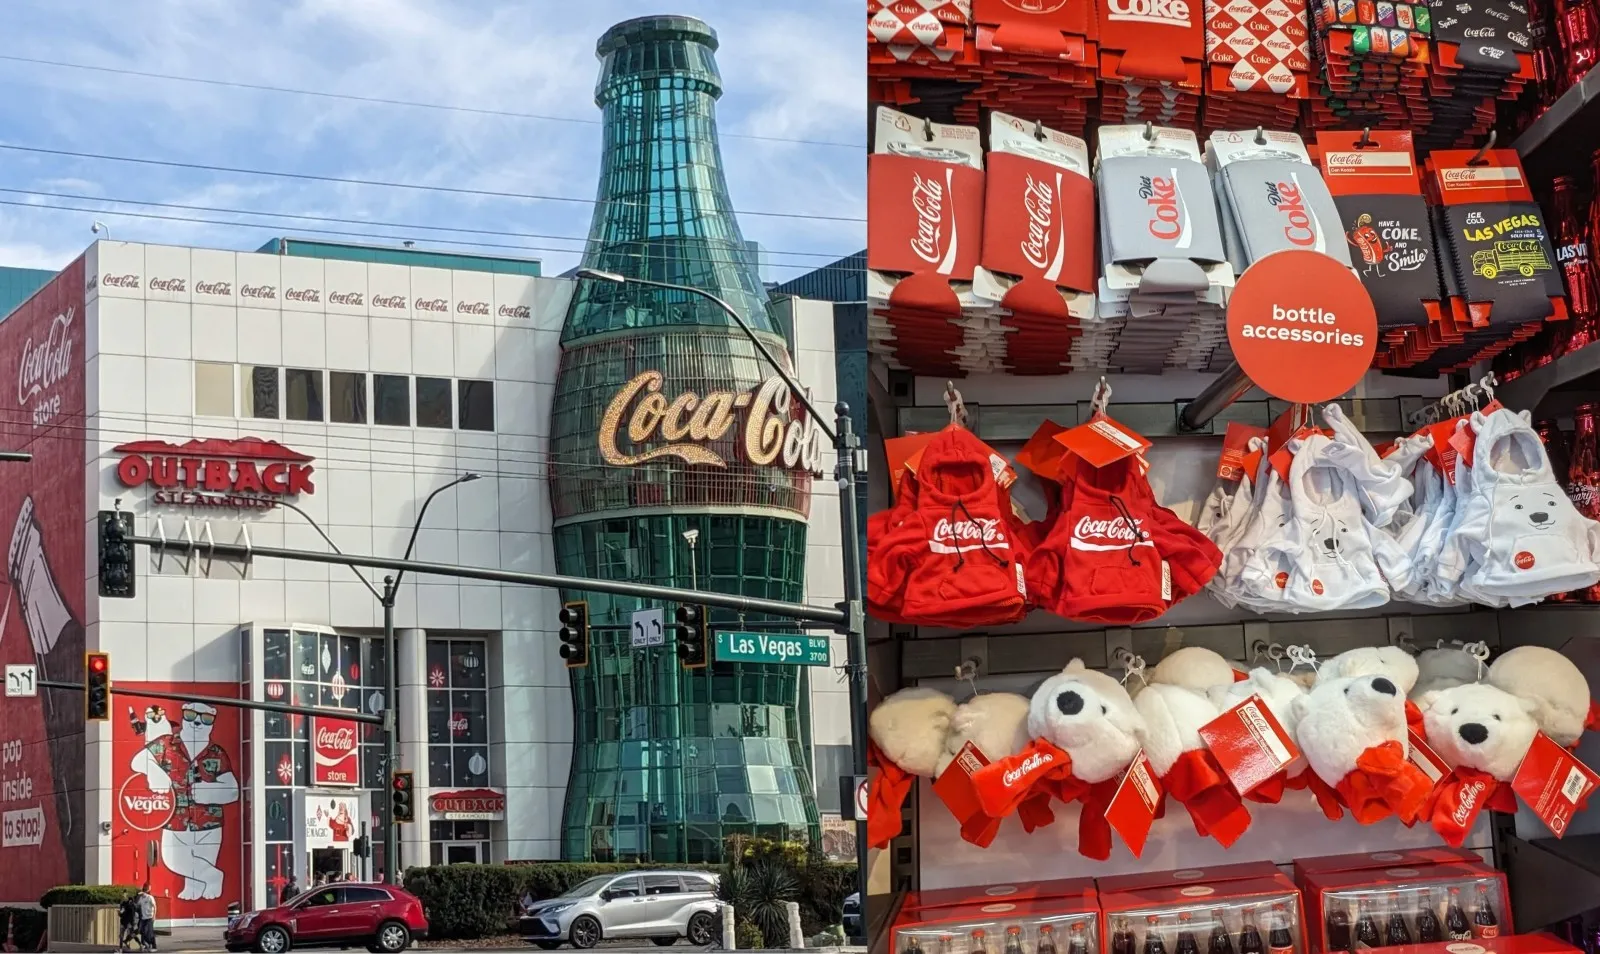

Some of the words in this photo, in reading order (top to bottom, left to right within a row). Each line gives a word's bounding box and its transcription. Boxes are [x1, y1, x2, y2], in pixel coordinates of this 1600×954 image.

[895, 4, 918, 14] Coke
[938, 9, 960, 20] Coke
[1108, 0, 1190, 20] Coke
[1508, 1, 1527, 14] Sprite
[1212, 20, 1232, 28] Coke
[1250, 21, 1270, 31] Coke
[1438, 18, 1458, 28] Sprite
[1286, 26, 1304, 36] Coke
[1464, 27, 1496, 38] Coca-Cola
[1508, 32, 1528, 48] Coke
[1212, 52, 1234, 61] Coke
[1251, 54, 1271, 64] Coke
[1288, 58, 1307, 69] Coke
[1330, 154, 1363, 165] Coca-Cola
[1445, 169, 1476, 180] Coca-Cola
[1139, 176, 1153, 200] Diet
[1267, 181, 1282, 206] Diet
[1148, 176, 1180, 240] Coke
[1276, 182, 1308, 246] Coke
[911, 170, 943, 263] Coca-Cola
[1021, 172, 1052, 268] Coca-Cola
[1382, 228, 1418, 240] COKE
[1463, 226, 1494, 241] LAS
[1493, 215, 1540, 235] VEGAS
[1498, 240, 1538, 252] Coca-Cola
[102, 273, 140, 288] Coca-Cola
[150, 277, 186, 292] Coca-Cola
[196, 281, 231, 296] Coca-Cola
[240, 284, 276, 299] Coca-Cola
[285, 288, 320, 302] Coca-Cola
[329, 291, 364, 306] Coca-Cola
[372, 294, 406, 309] Coca-Cola
[415, 298, 448, 312] Coca-Cola
[456, 301, 489, 315] Coca-Cola
[498, 304, 531, 319] Coca-Cola
[1272, 304, 1336, 325] bottle
[1241, 322, 1364, 347] accessories
[18, 305, 76, 406] Coca-Cola
[33, 394, 60, 429] store
[598, 369, 823, 479] Coca-Cola
[117, 454, 315, 495] OUTBACK
[154, 490, 282, 509] STEAKHOUSE
[730, 634, 755, 654] Las
[759, 636, 803, 661] Vegas
[809, 639, 826, 648] BLVD
[810, 653, 827, 662] 3700
[1245, 706, 1269, 734] Coca-Cola
[317, 726, 354, 750] Coca-Cola
[3, 738, 22, 768] pop
[327, 770, 347, 781] store
[3, 771, 32, 800] inside
[124, 796, 170, 814] Vegas
[432, 799, 504, 812] OUTBACK
[1452, 782, 1478, 827] Coca-Cola
[4, 820, 14, 838] to
[16, 811, 40, 840] shop!
